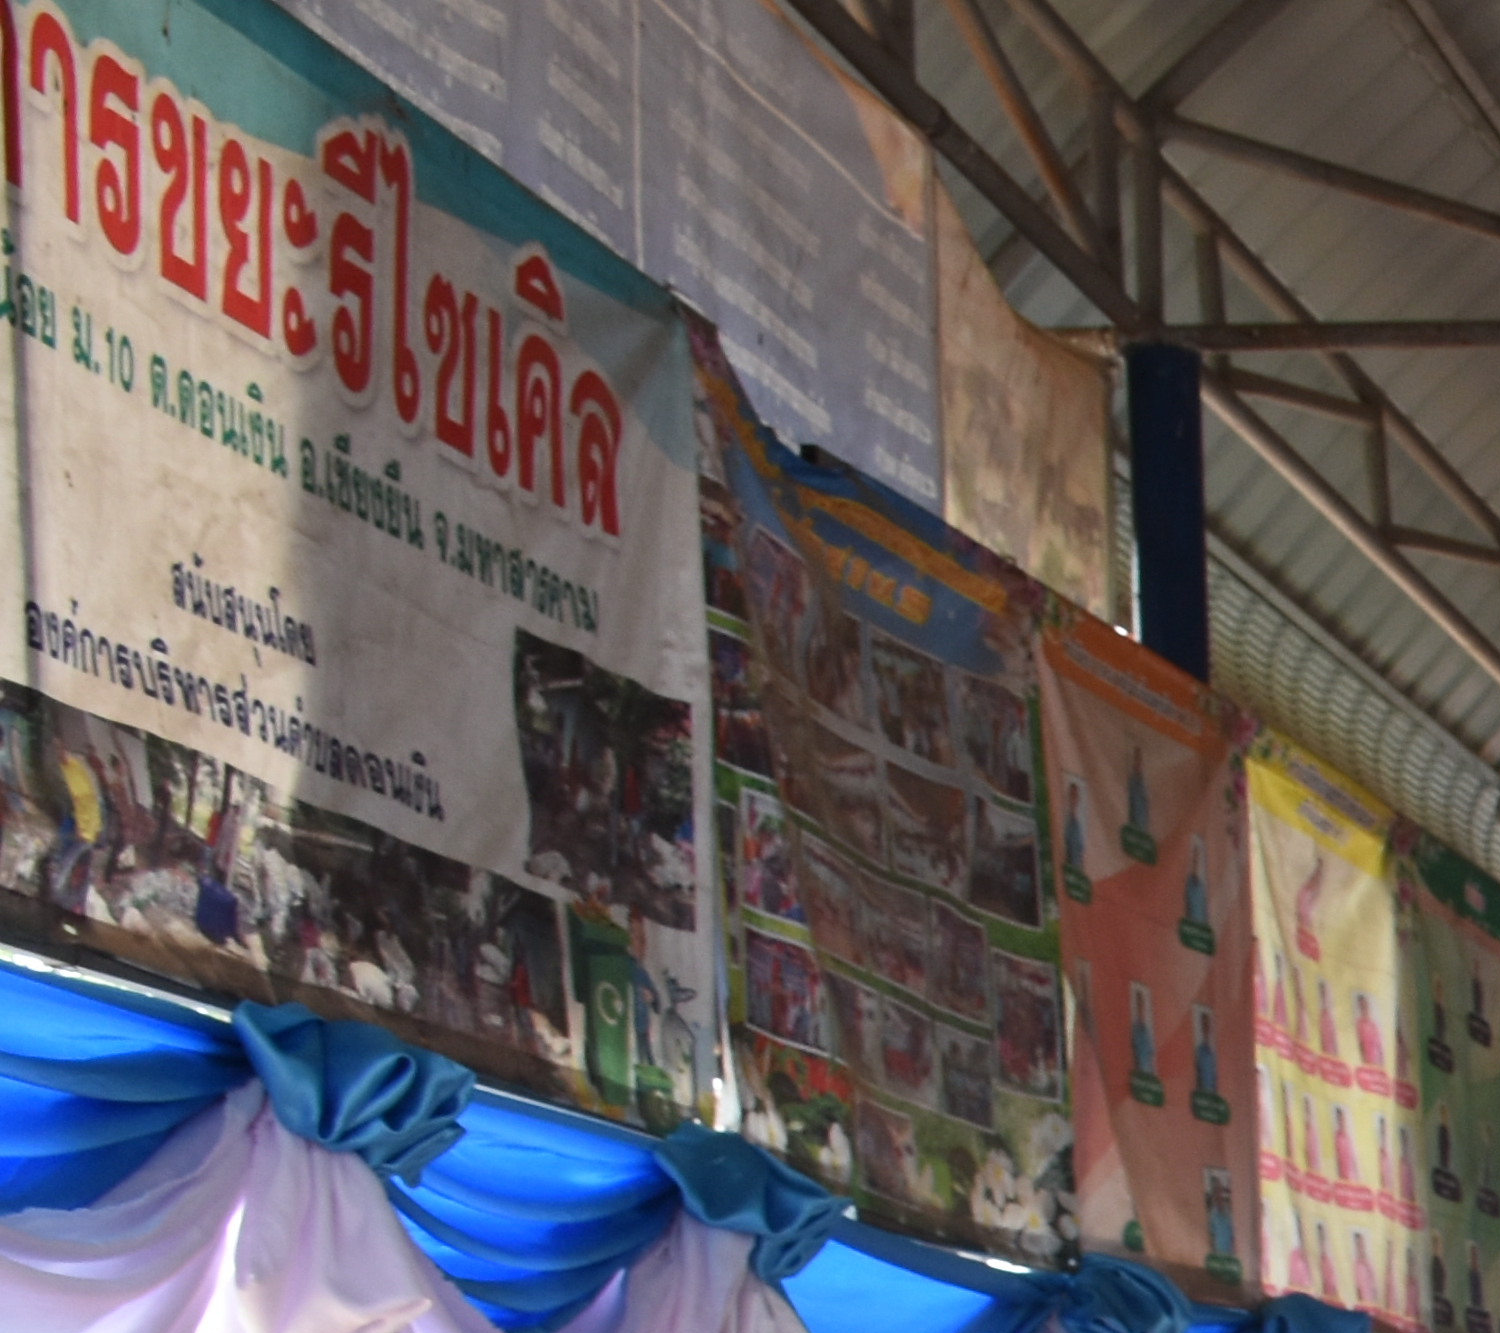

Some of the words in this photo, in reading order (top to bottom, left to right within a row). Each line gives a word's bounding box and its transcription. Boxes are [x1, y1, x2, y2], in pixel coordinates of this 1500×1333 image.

[0, 4, 622, 536] ารขยะรีไซเคิล
